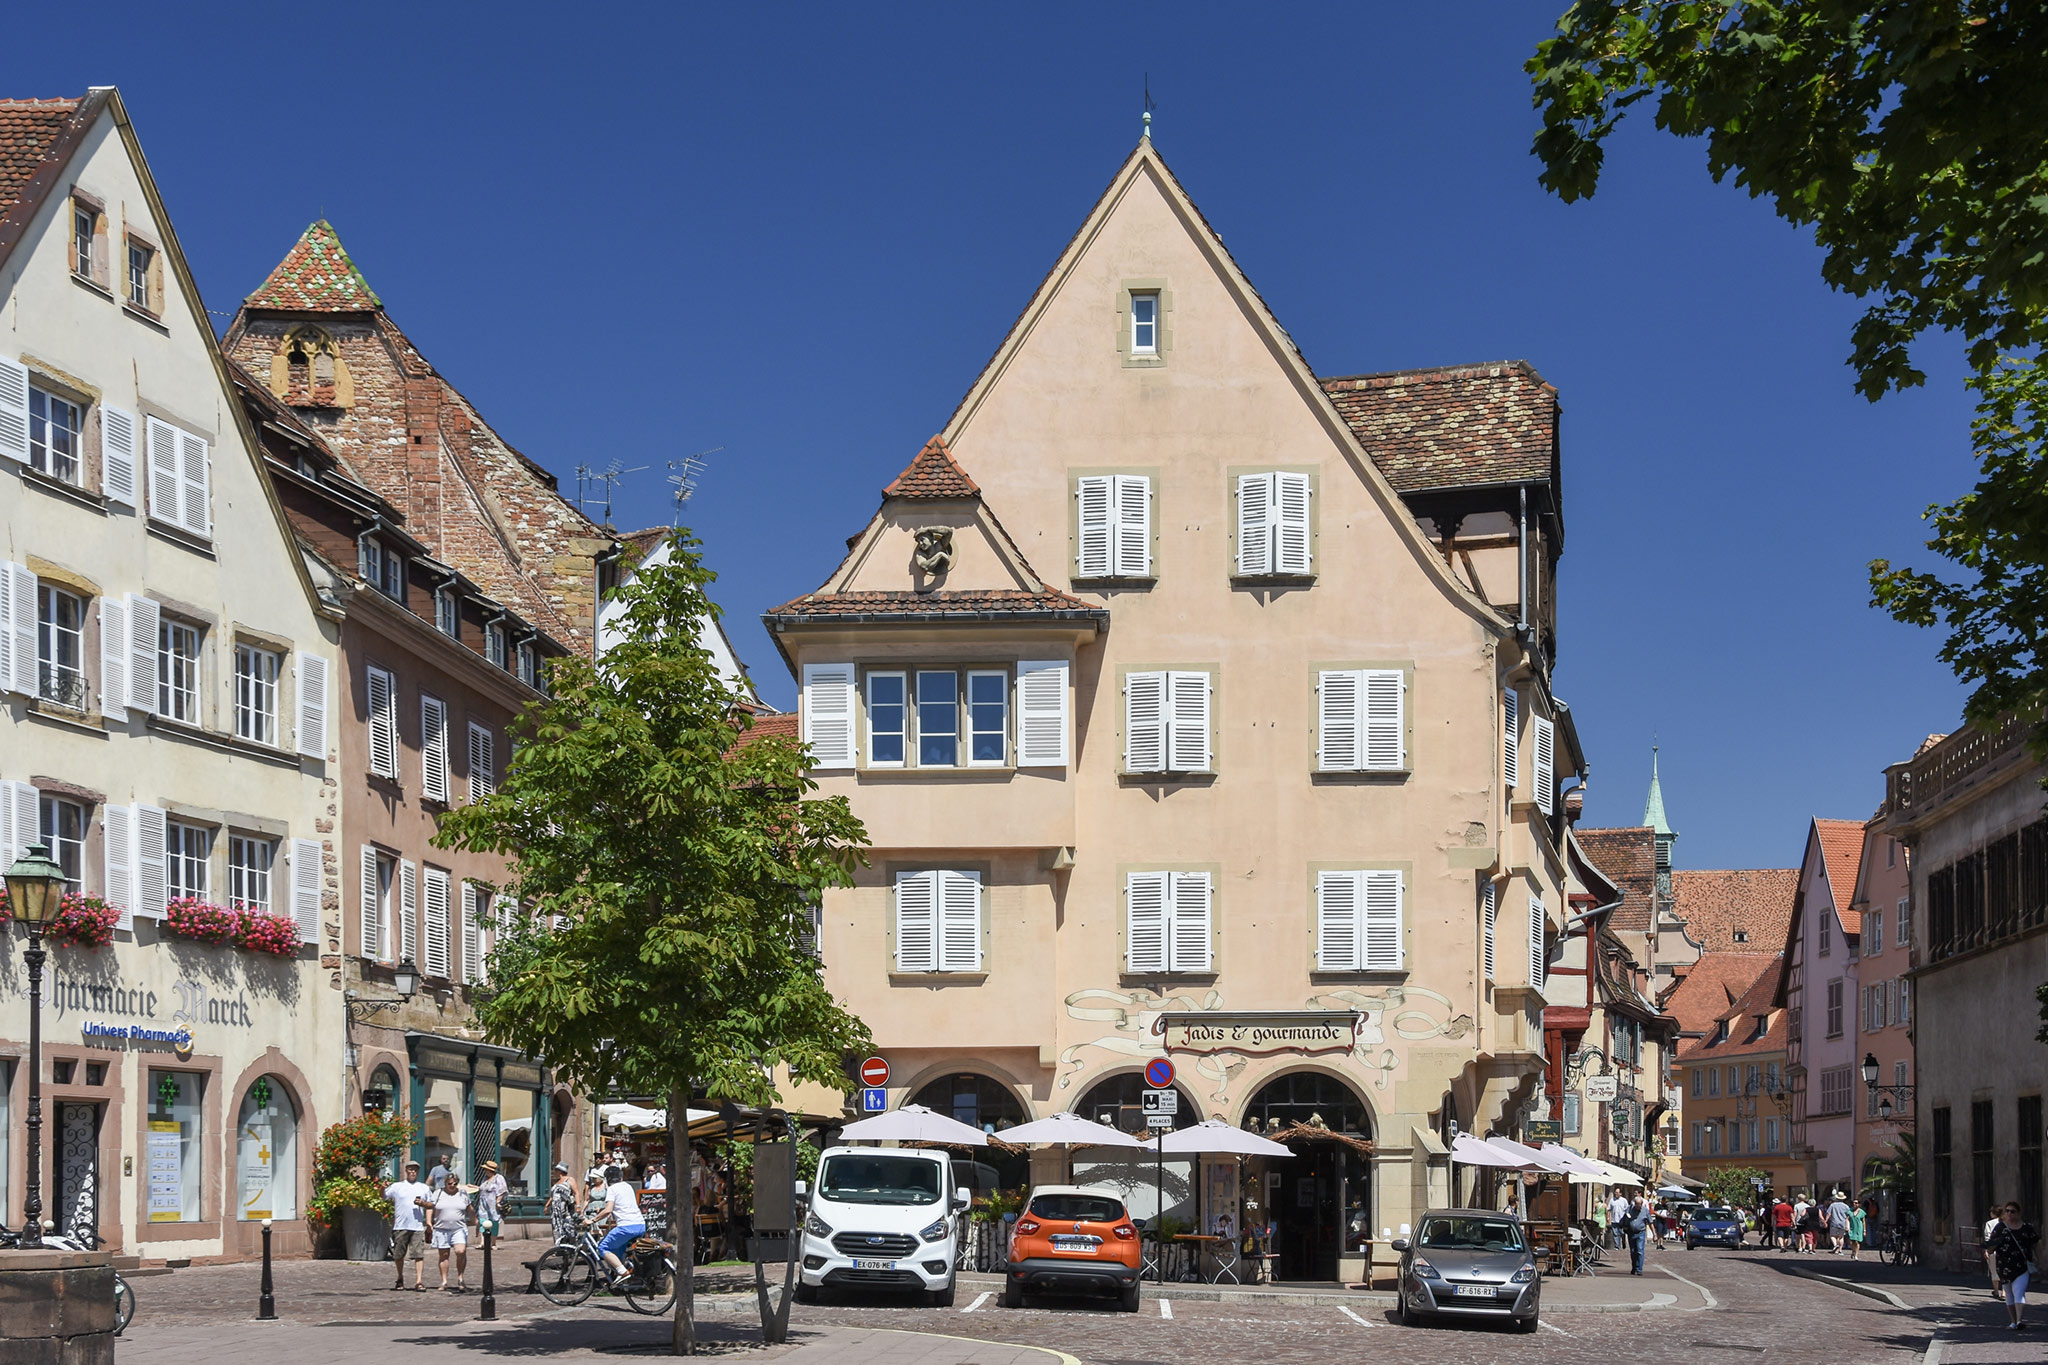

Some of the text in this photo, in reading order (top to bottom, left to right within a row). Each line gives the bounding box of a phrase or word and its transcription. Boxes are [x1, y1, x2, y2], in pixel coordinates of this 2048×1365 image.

[173, 979, 253, 1029] Marck
[83, 1021, 191, 1043] Univers Pharmacie
[1181, 1020, 1342, 1046] Jadis & gourmande
[857, 1261, 891, 1269] EX-076-ME
[1458, 1286, 1492, 1295] CF-616-RX
